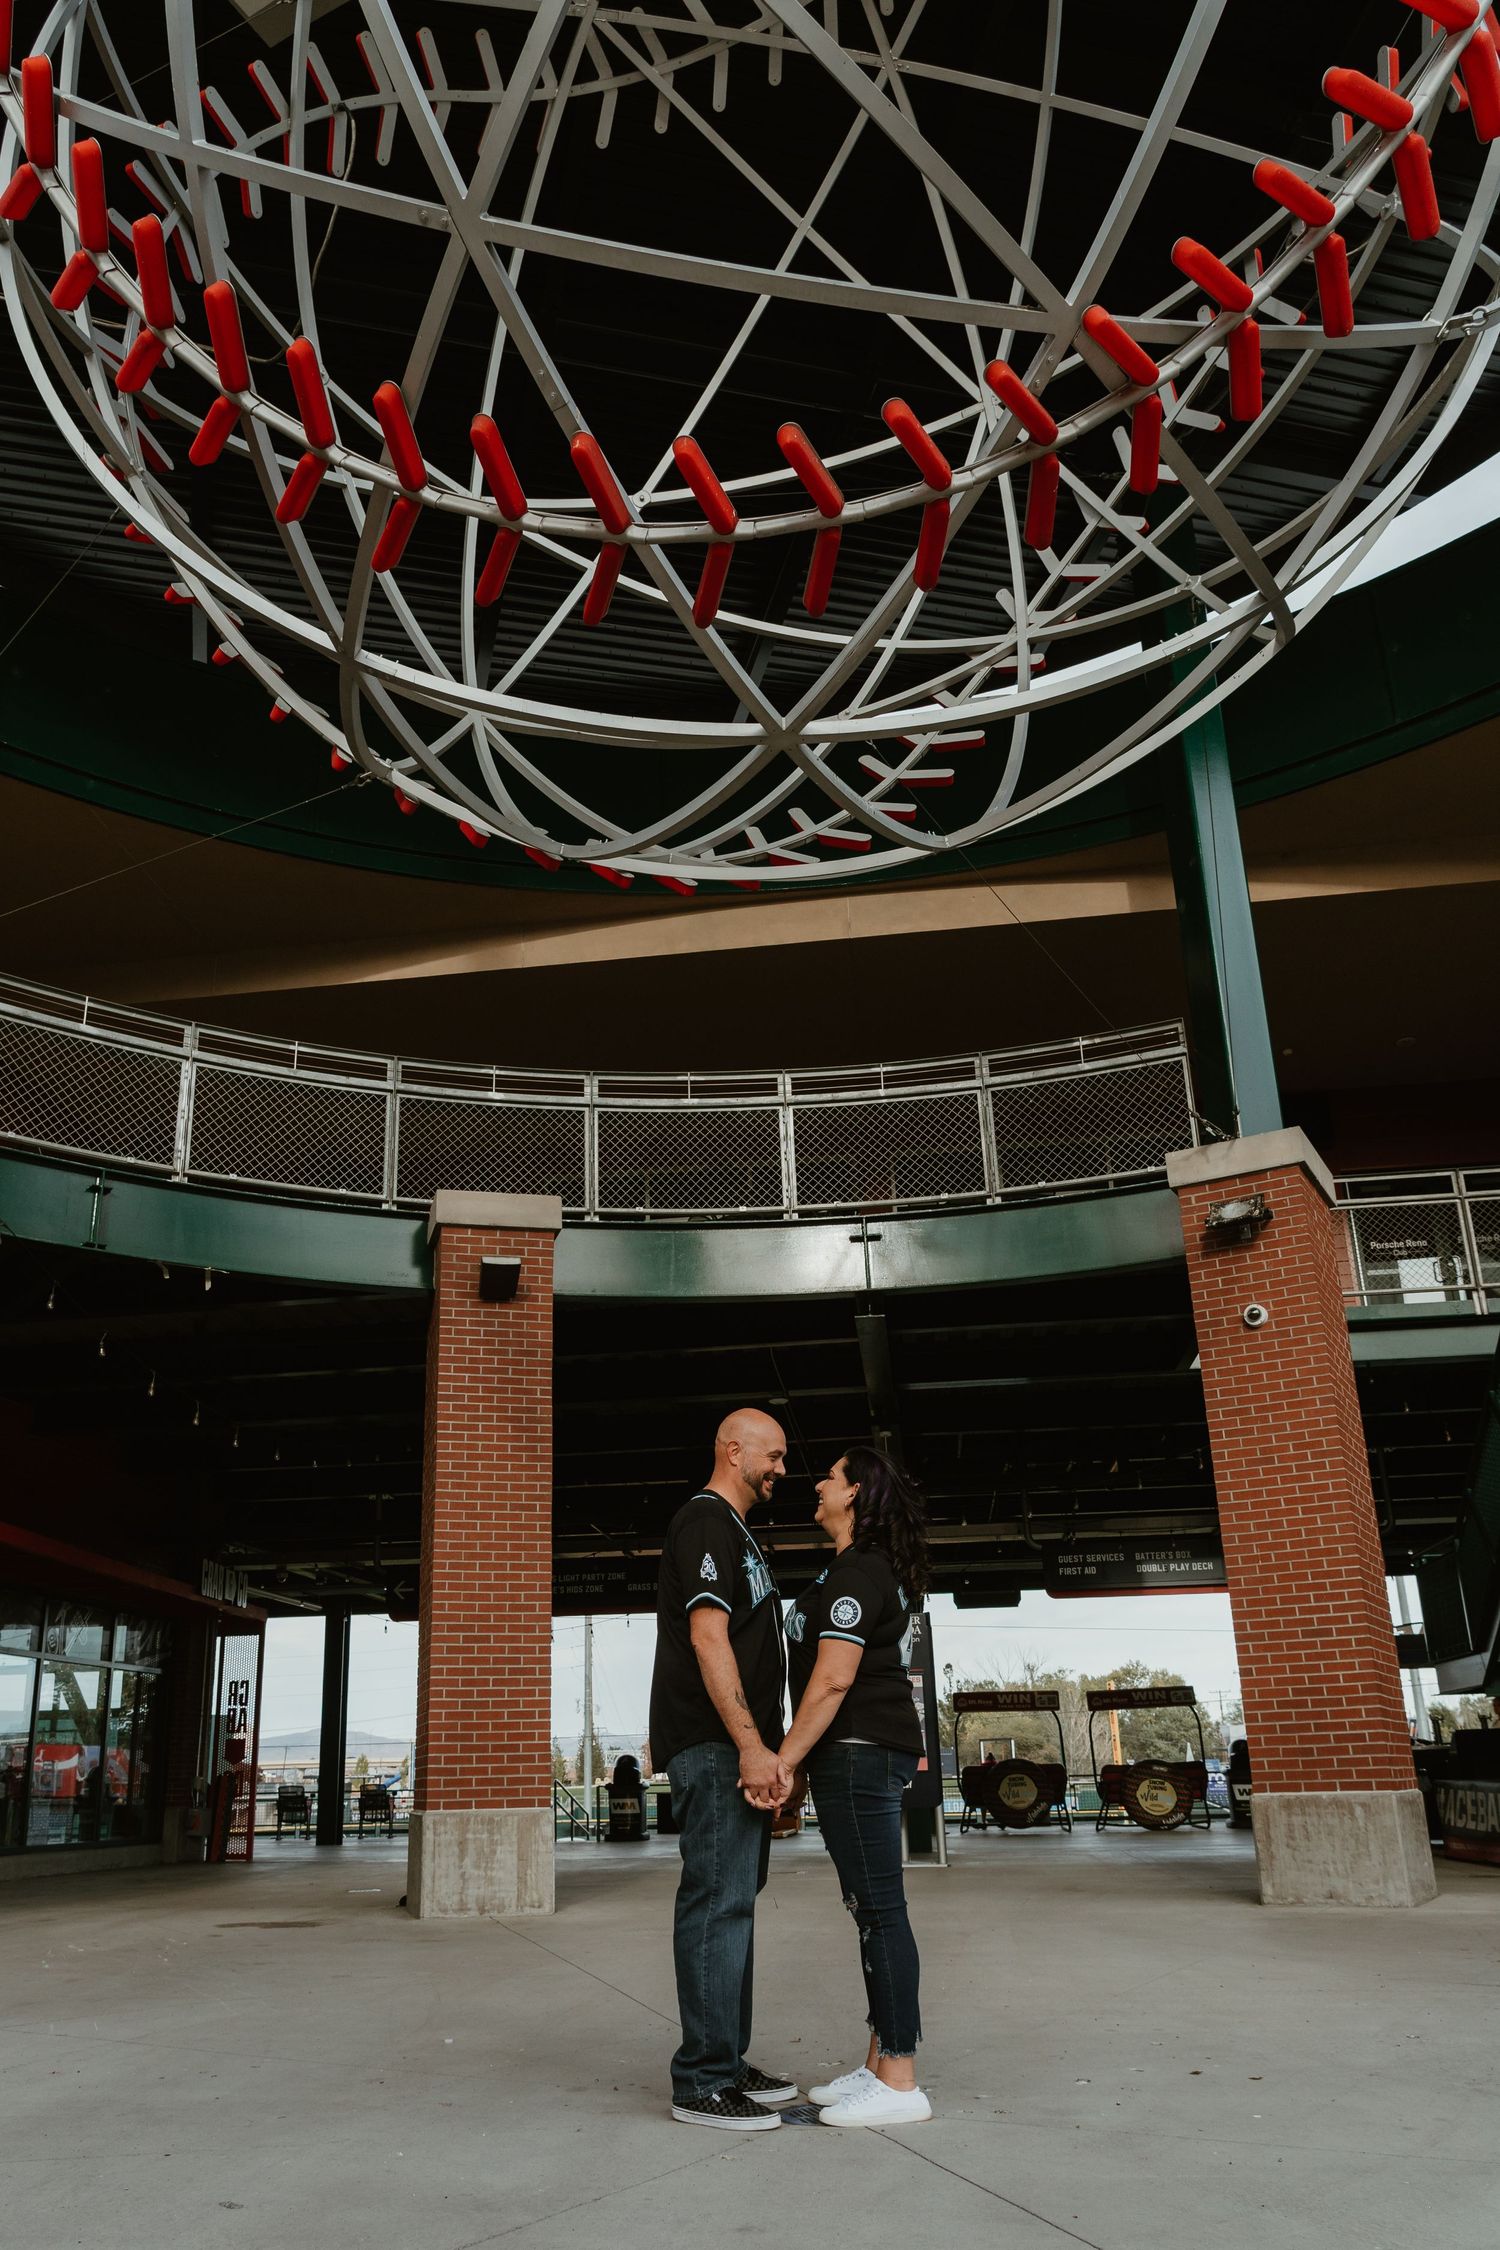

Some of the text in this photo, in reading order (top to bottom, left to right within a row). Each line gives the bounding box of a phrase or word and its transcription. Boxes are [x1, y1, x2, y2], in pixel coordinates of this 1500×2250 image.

[1370, 1240, 1405, 1250] Porsche
[1058, 1553, 1125, 1564] GUEST SERVICES
[1135, 1550, 1192, 1561] BATTER'S BOX
[1059, 1566, 1097, 1576] FIRST AID
[1137, 1563, 1167, 1573] DOUBLE
[1169, 1562, 1190, 1572] PLAY
[201, 1558, 225, 1601] GRAB
[607, 1571, 627, 1581] ZONE
[996, 1693, 1032, 1704] WIN
[1131, 1690, 1167, 1702] WIN
[1238, 1788, 1251, 1797] W
